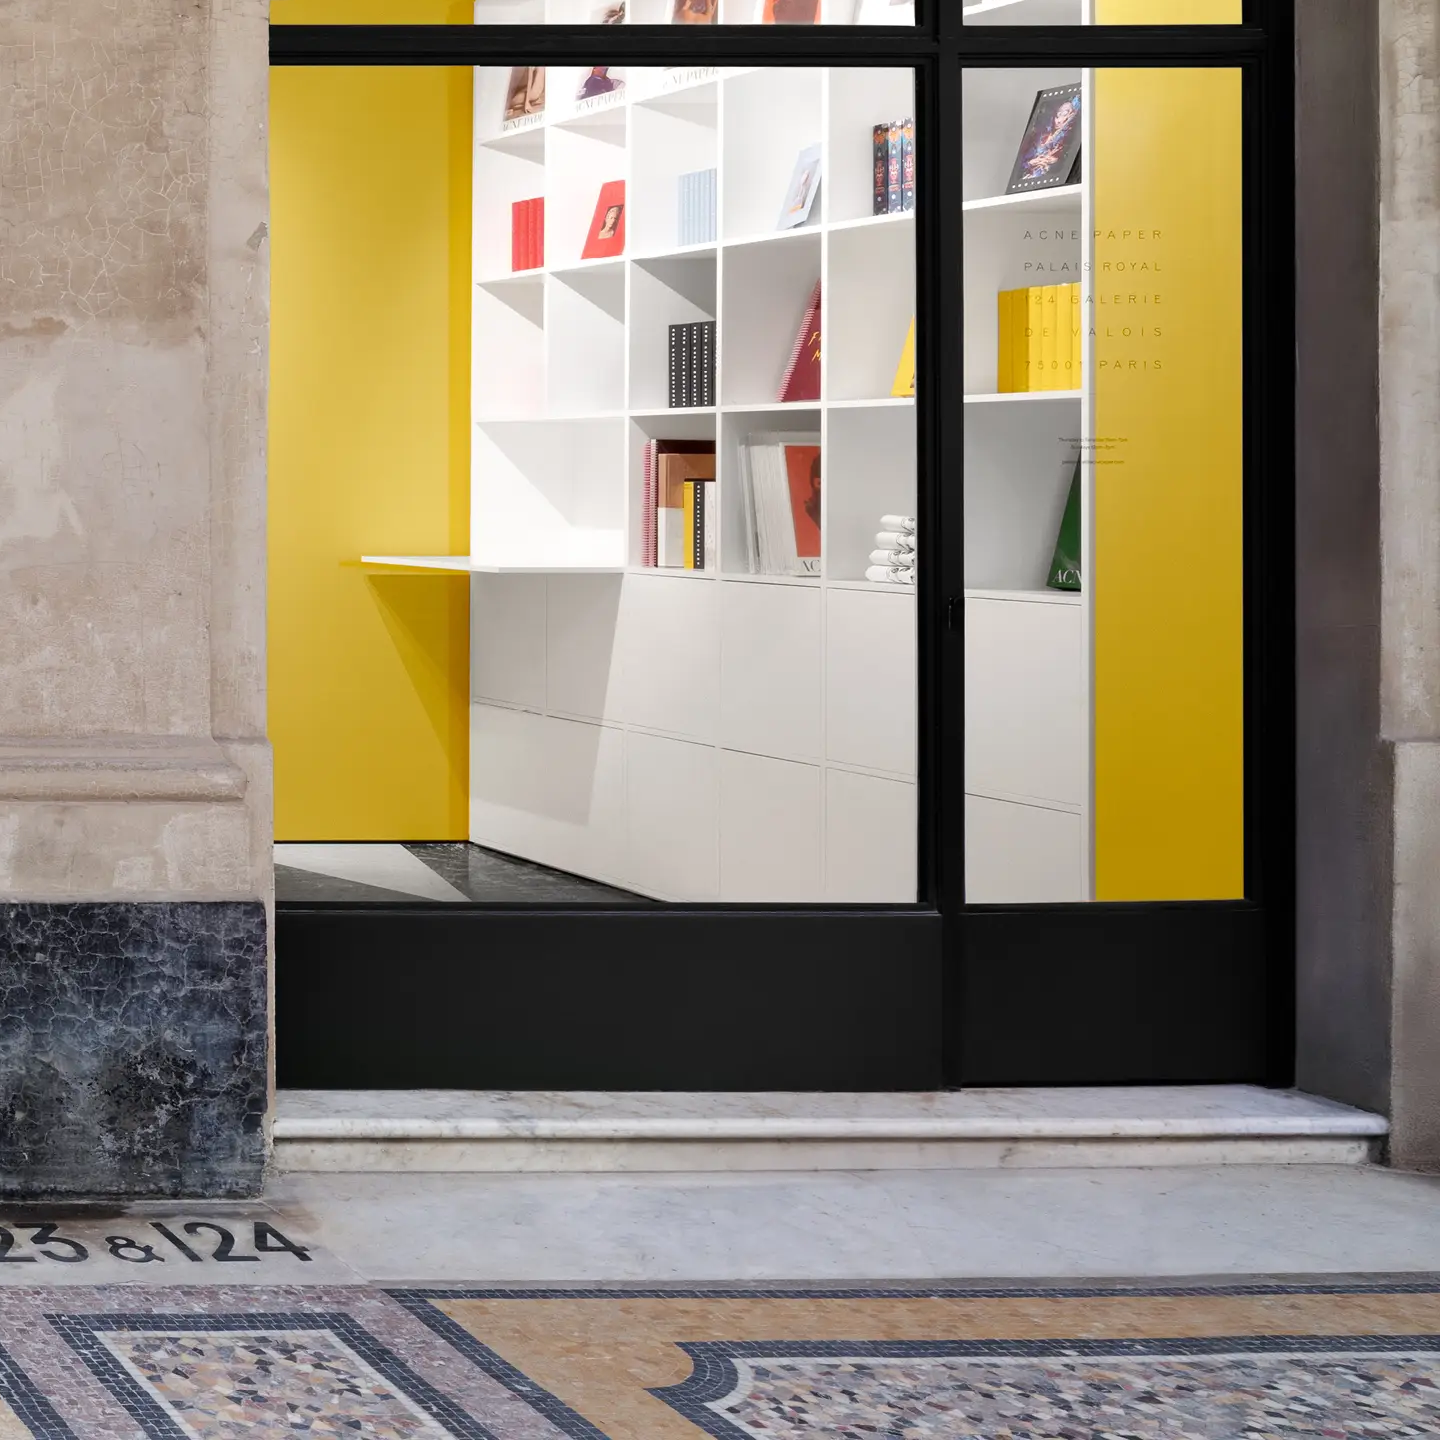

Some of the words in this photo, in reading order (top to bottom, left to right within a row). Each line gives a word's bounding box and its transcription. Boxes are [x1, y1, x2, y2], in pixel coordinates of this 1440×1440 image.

[1023, 229, 1079, 241] ACNE
[1093, 229, 1163, 241] PAPER
[1023, 261, 1092, 273] PALAIS
[1102, 261, 1162, 273] ROYAL
[1024, 294, 1056, 305] 124
[1070, 294, 1162, 305] GALERIE
[1024, 326, 1051, 338] DE
[1072, 326, 1163, 338] VALOIS
[1024, 360, 1084, 371] 75001
[1099, 360, 1163, 371] PARIS
[104, 1235, 166, 1263] &
[149, 1220, 314, 1263] 124
